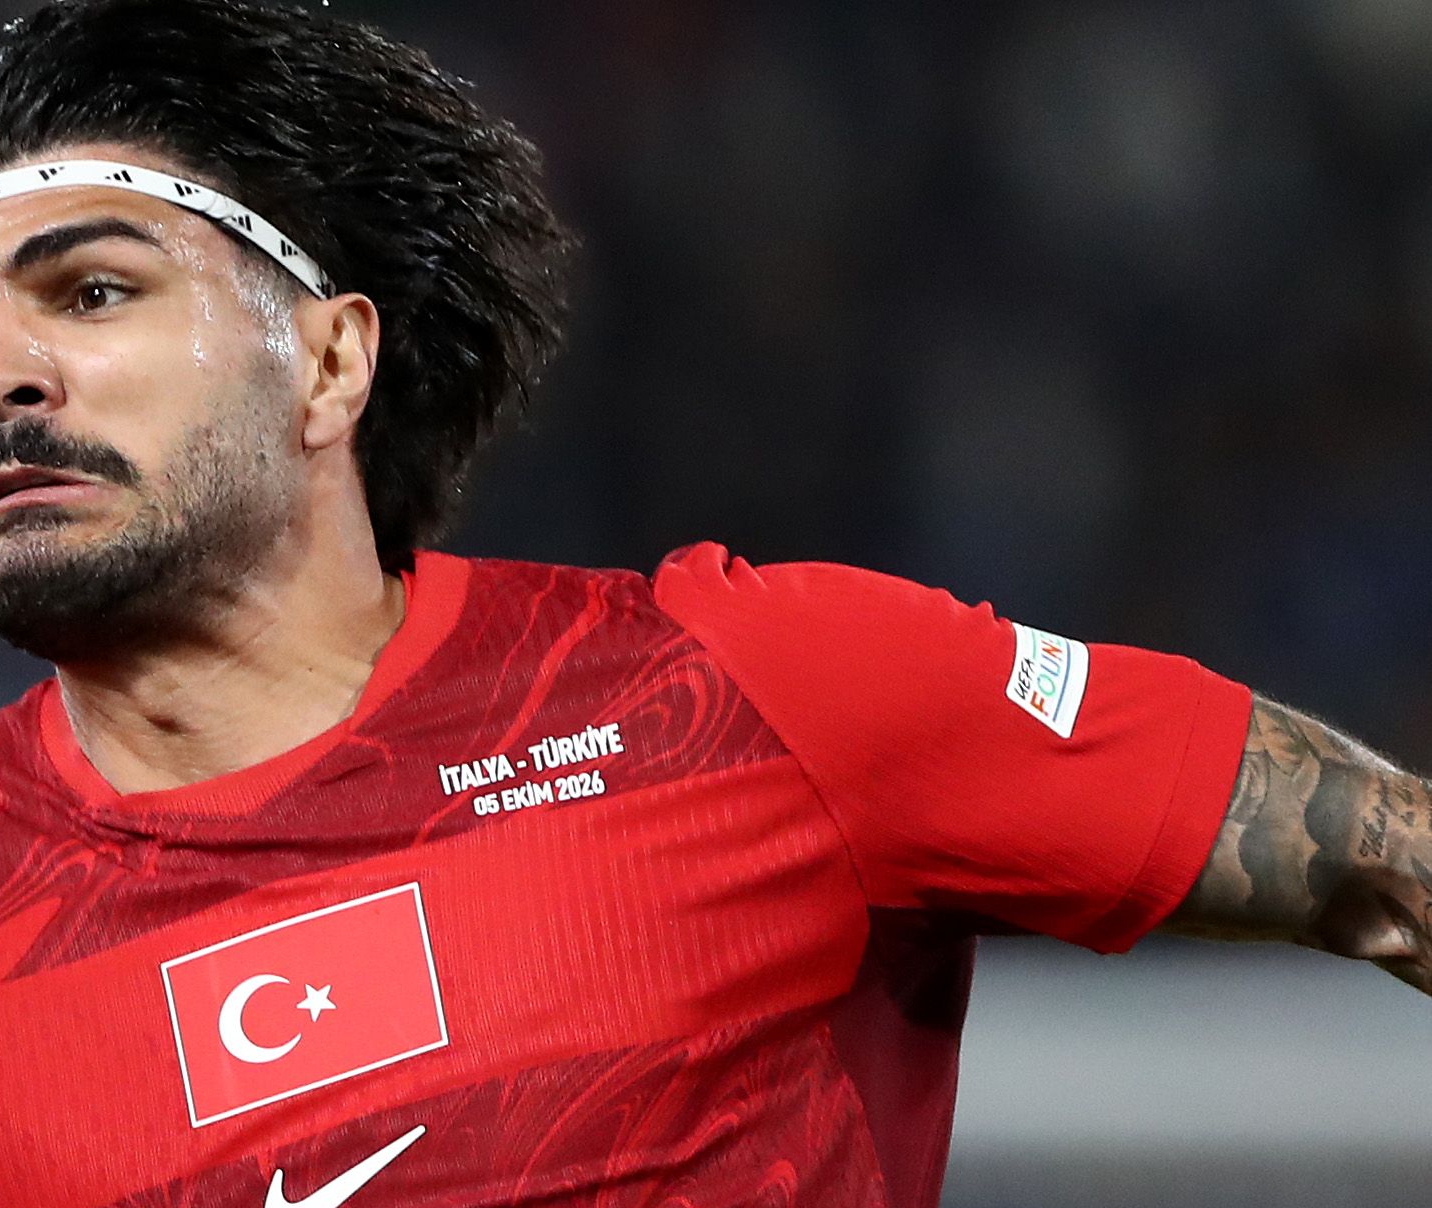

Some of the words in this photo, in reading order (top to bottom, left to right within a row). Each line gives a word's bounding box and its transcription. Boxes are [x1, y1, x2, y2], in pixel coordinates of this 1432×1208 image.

[1013, 657, 1035, 700] UEFA
[439, 754, 516, 796] İTALYA
[516, 760, 527, 769] -
[528, 722, 624, 772] TÜRKİYE
[473, 792, 500, 816] 05
[501, 779, 555, 812] EKİM
[554, 769, 606, 801] 2026
